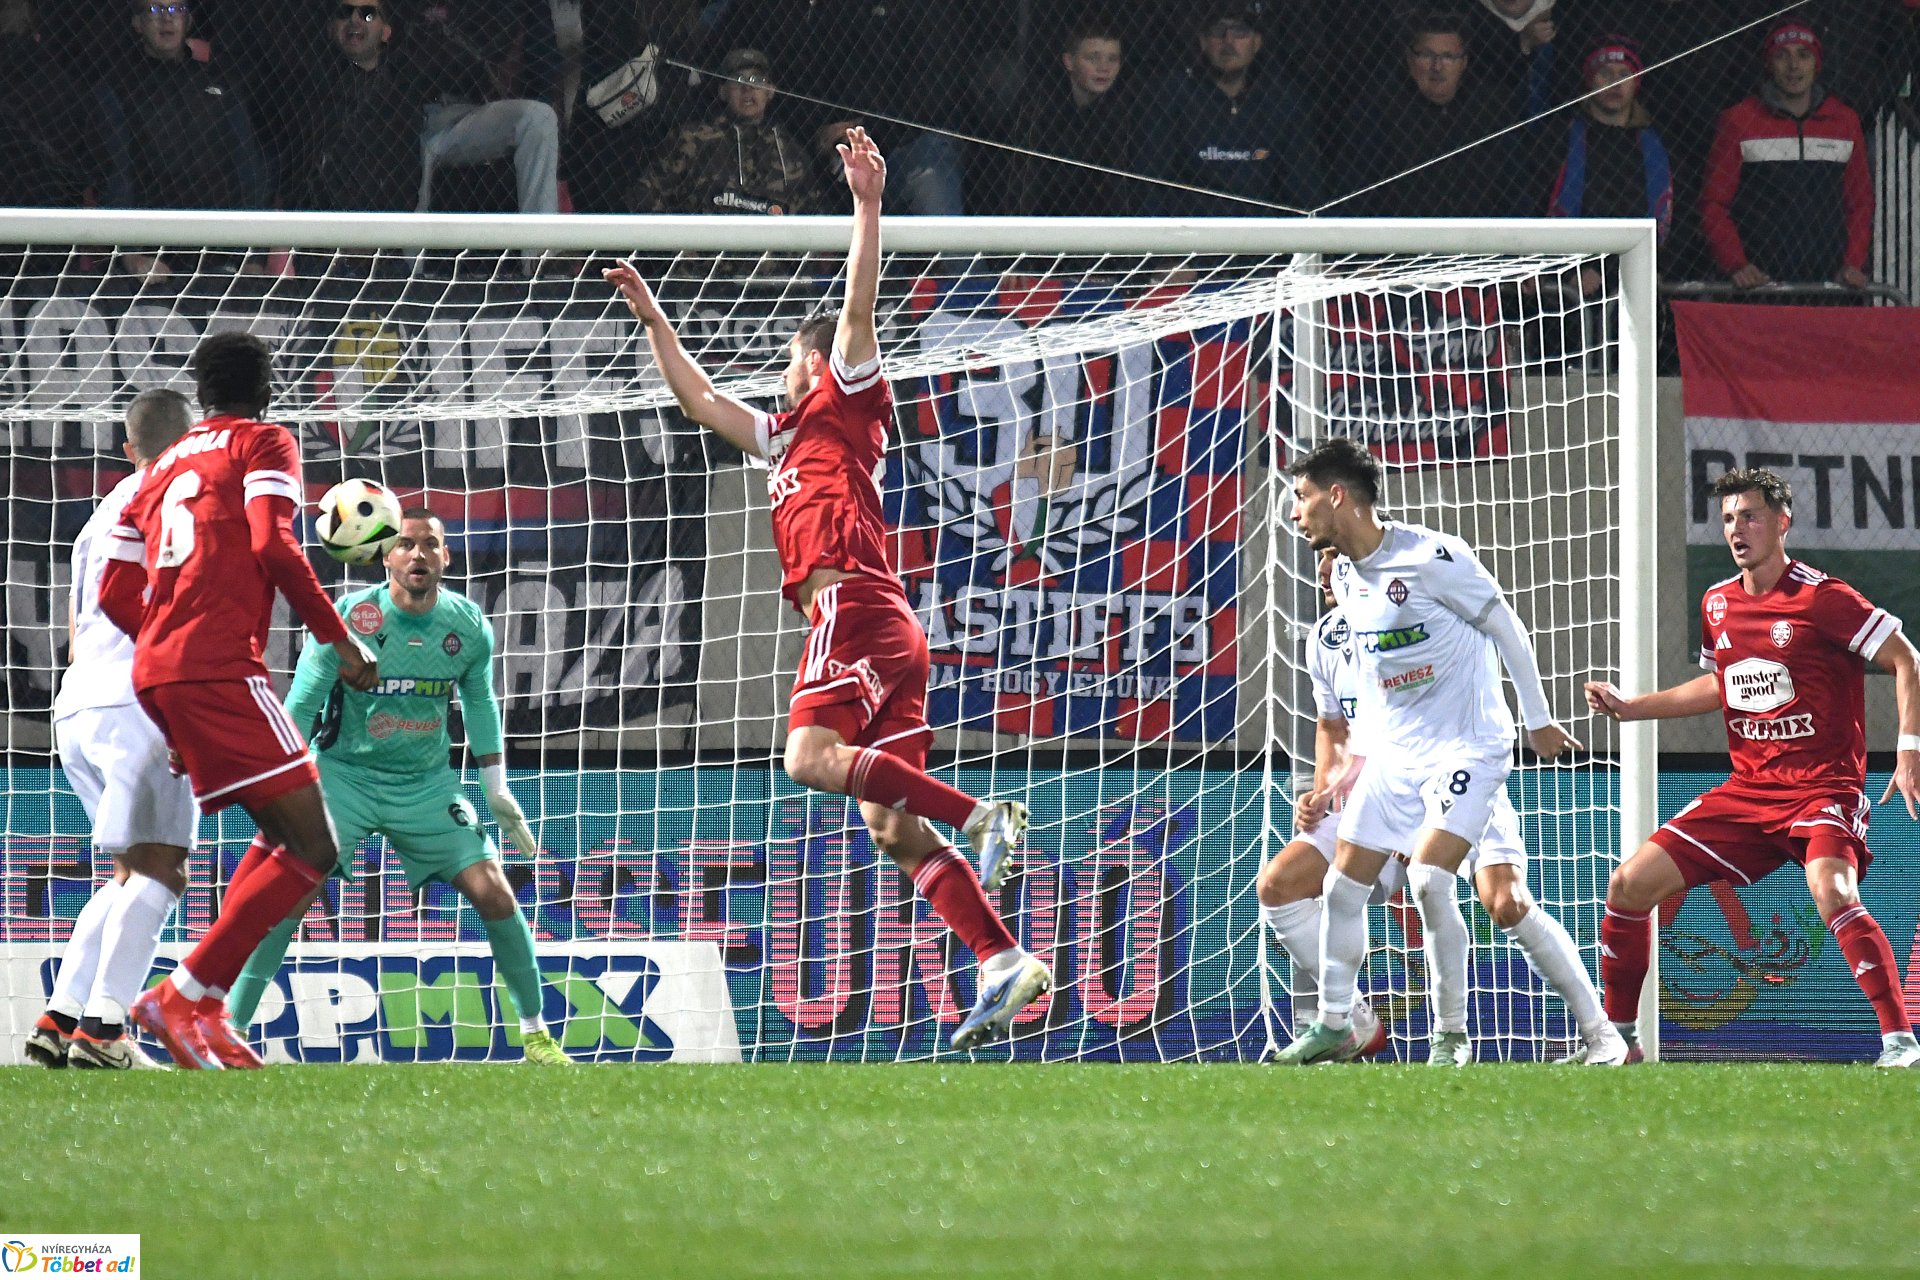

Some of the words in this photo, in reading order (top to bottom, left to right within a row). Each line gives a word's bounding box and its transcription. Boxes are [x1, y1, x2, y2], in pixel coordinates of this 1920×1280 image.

[1199, 146, 1251, 161] ellesse
[713, 192, 767, 212] ellesse
[156, 469, 201, 569] 6
[981, 667, 1064, 696] HOGY
[1732, 670, 1782, 686] master
[1740, 681, 1776, 701] good
[447, 803, 471, 827] 6
